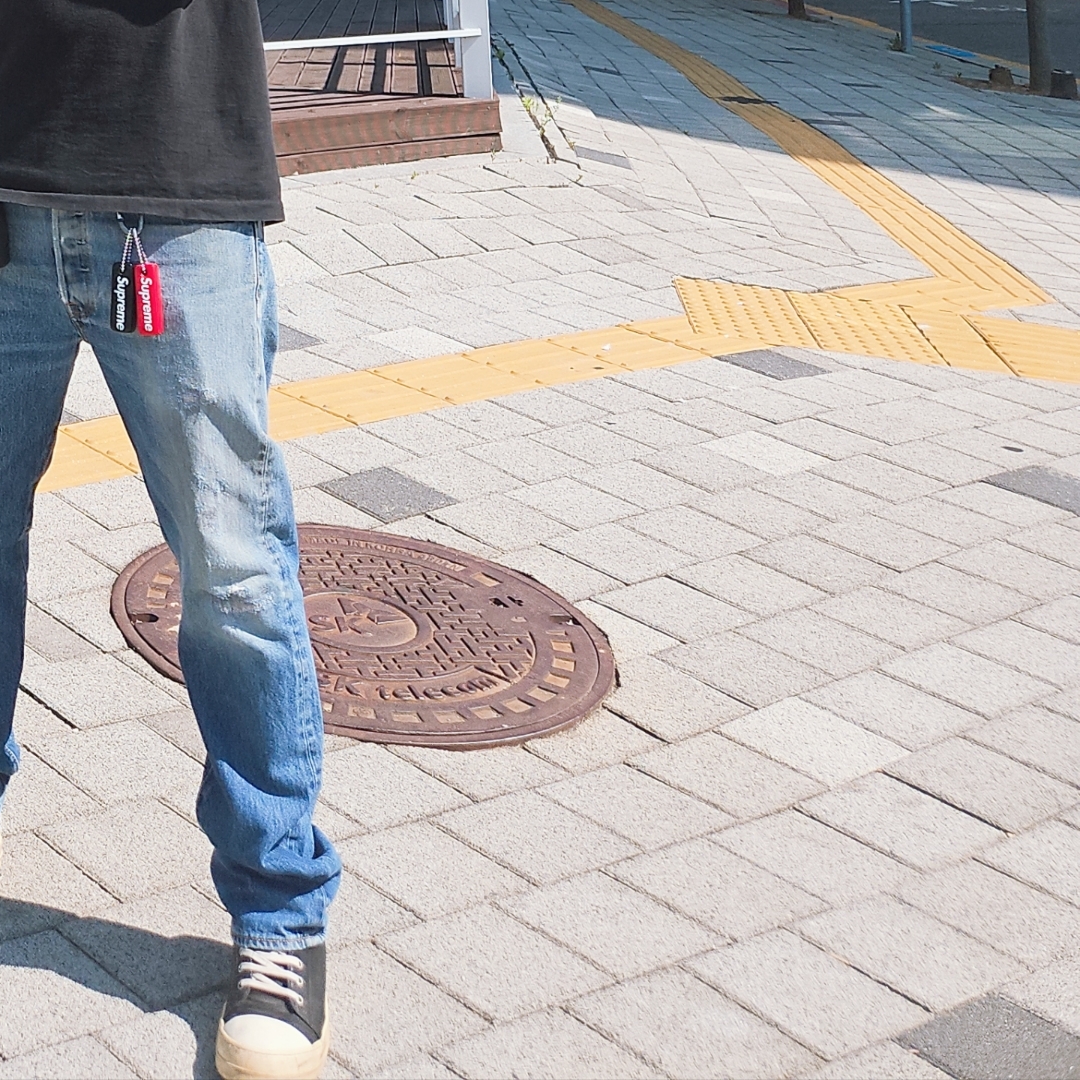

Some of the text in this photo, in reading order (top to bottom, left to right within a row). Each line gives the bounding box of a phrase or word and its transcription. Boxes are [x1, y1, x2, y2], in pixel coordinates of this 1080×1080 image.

[113, 275, 130, 332] Supreme
[137, 276, 154, 333] Supreme
[308, 614, 373, 637] SK
[375, 675, 499, 701] telecom
